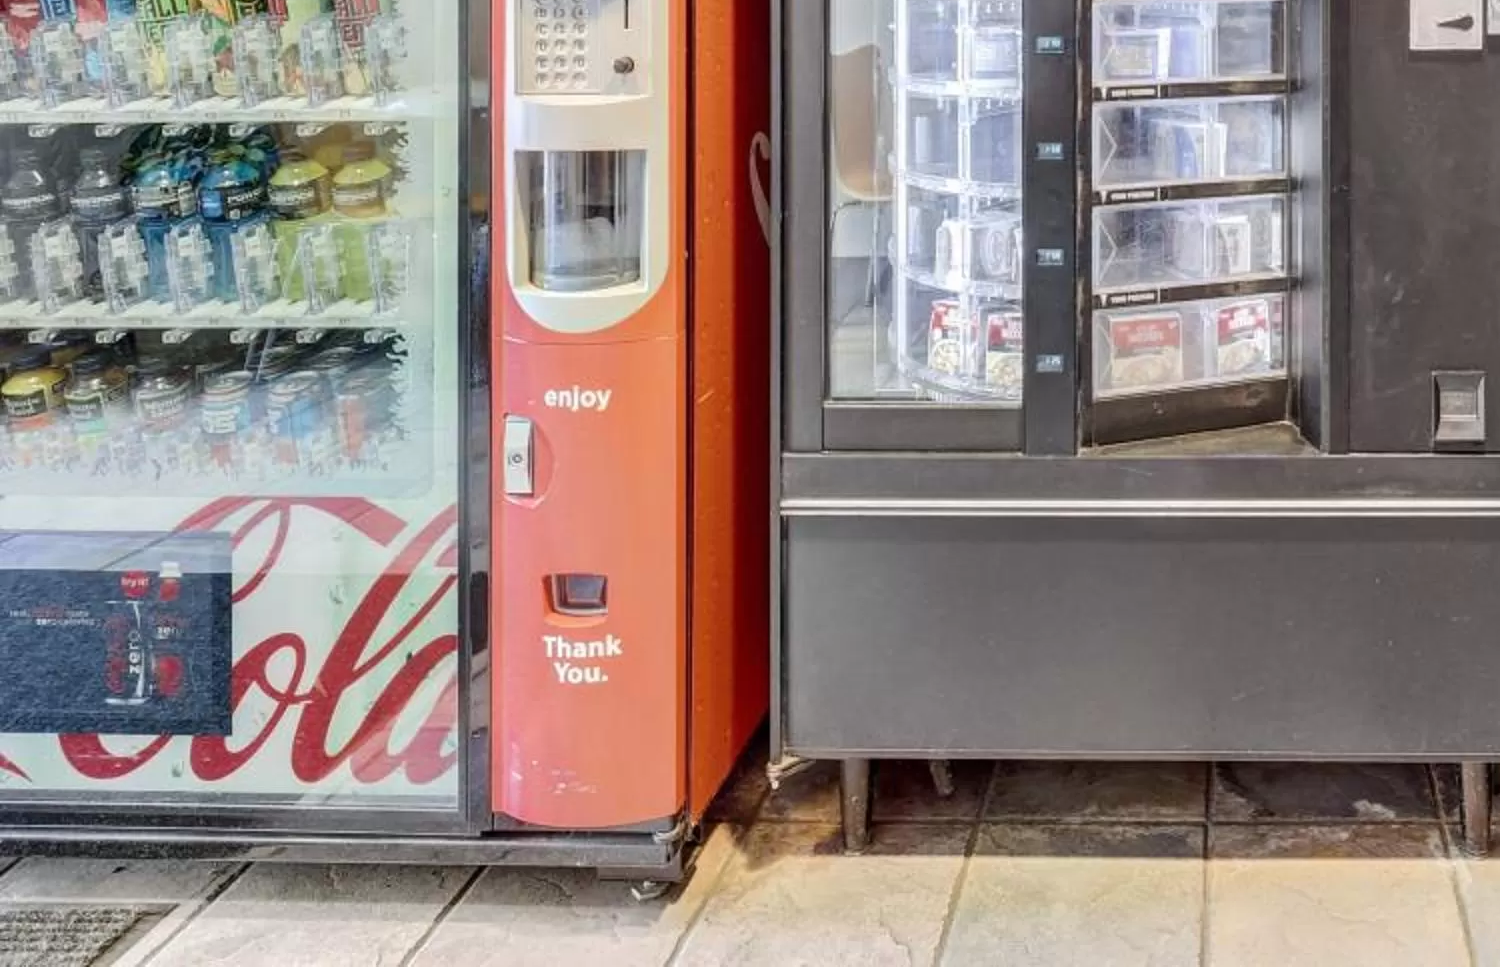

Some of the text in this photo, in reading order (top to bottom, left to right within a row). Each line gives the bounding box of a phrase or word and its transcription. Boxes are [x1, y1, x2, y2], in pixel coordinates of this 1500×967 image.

[544, 385, 612, 412] enjoy
[544, 635, 622, 658] Thank
[554, 662, 608, 684] You.
